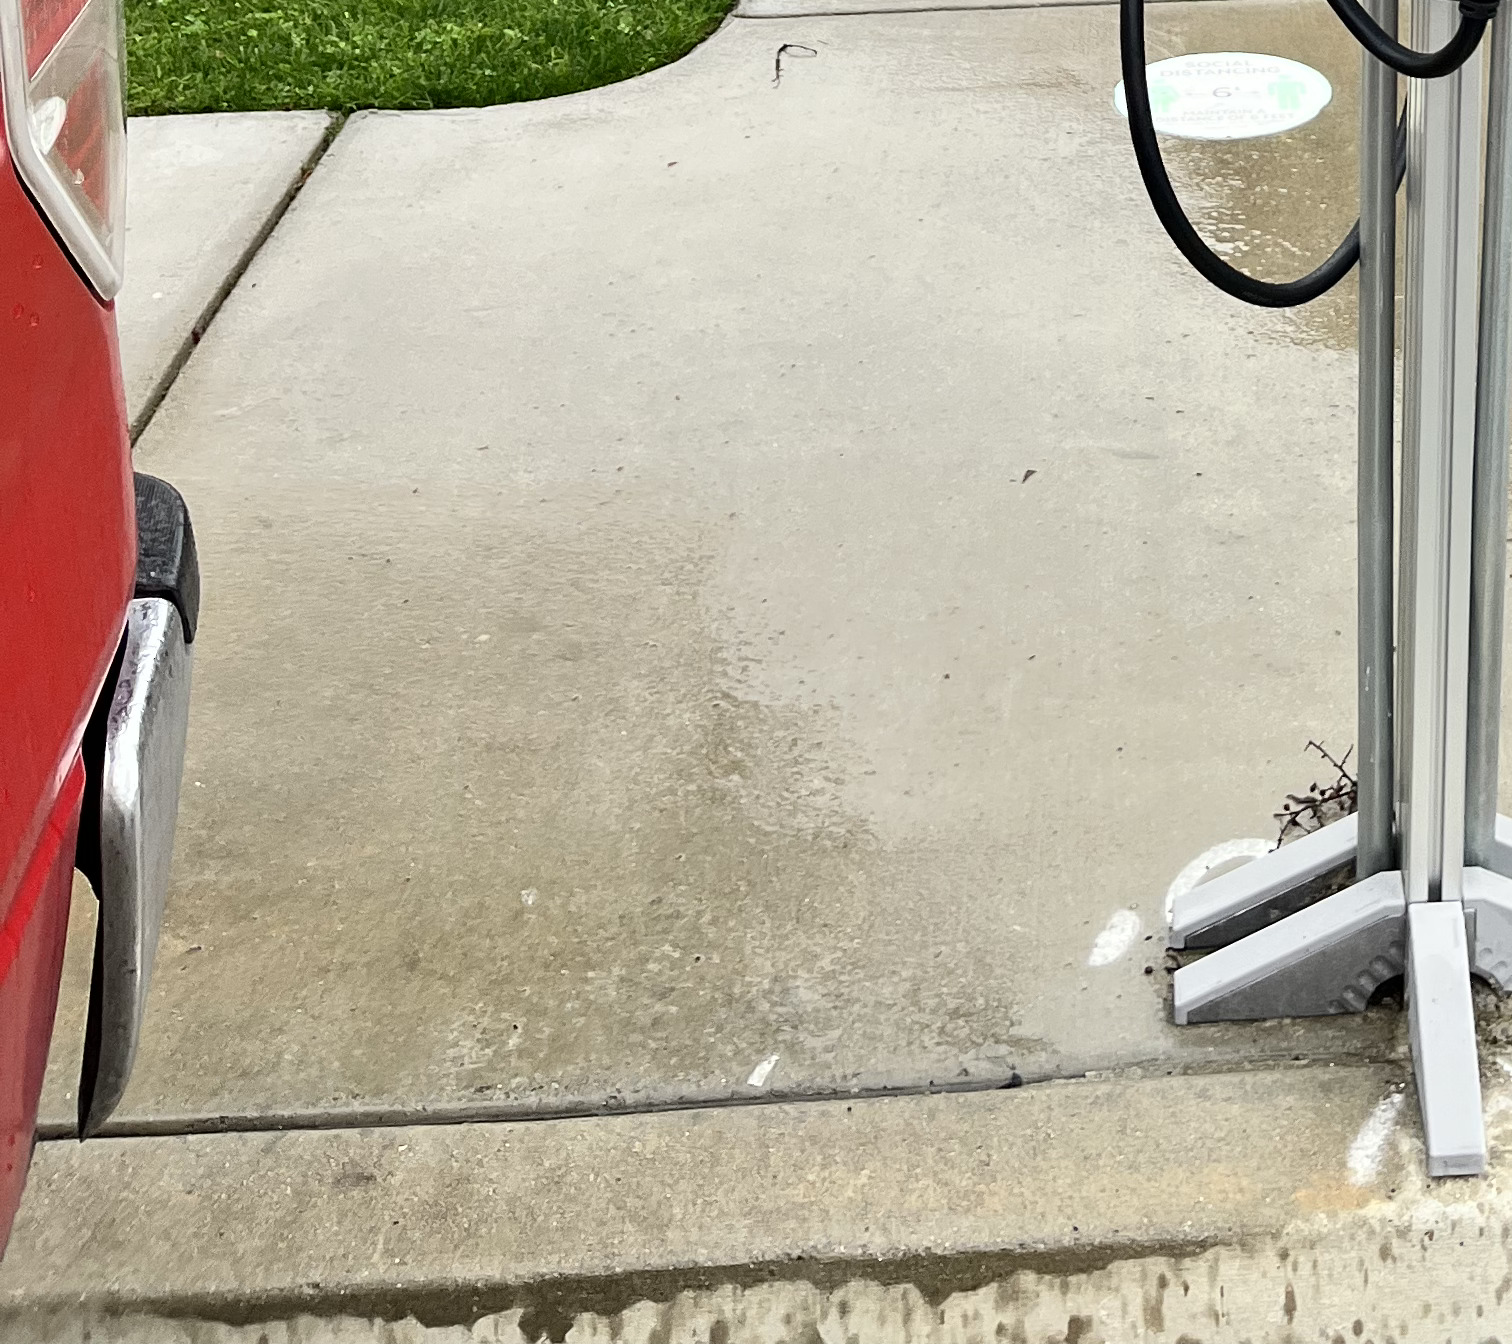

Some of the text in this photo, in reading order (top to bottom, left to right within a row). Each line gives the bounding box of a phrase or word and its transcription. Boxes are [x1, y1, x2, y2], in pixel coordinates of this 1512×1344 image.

[1185, 60, 1254, 68] SOCIAL
[1160, 66, 1281, 77] DISTANCING
[1183, 108, 1253, 116] MAINTAIN
